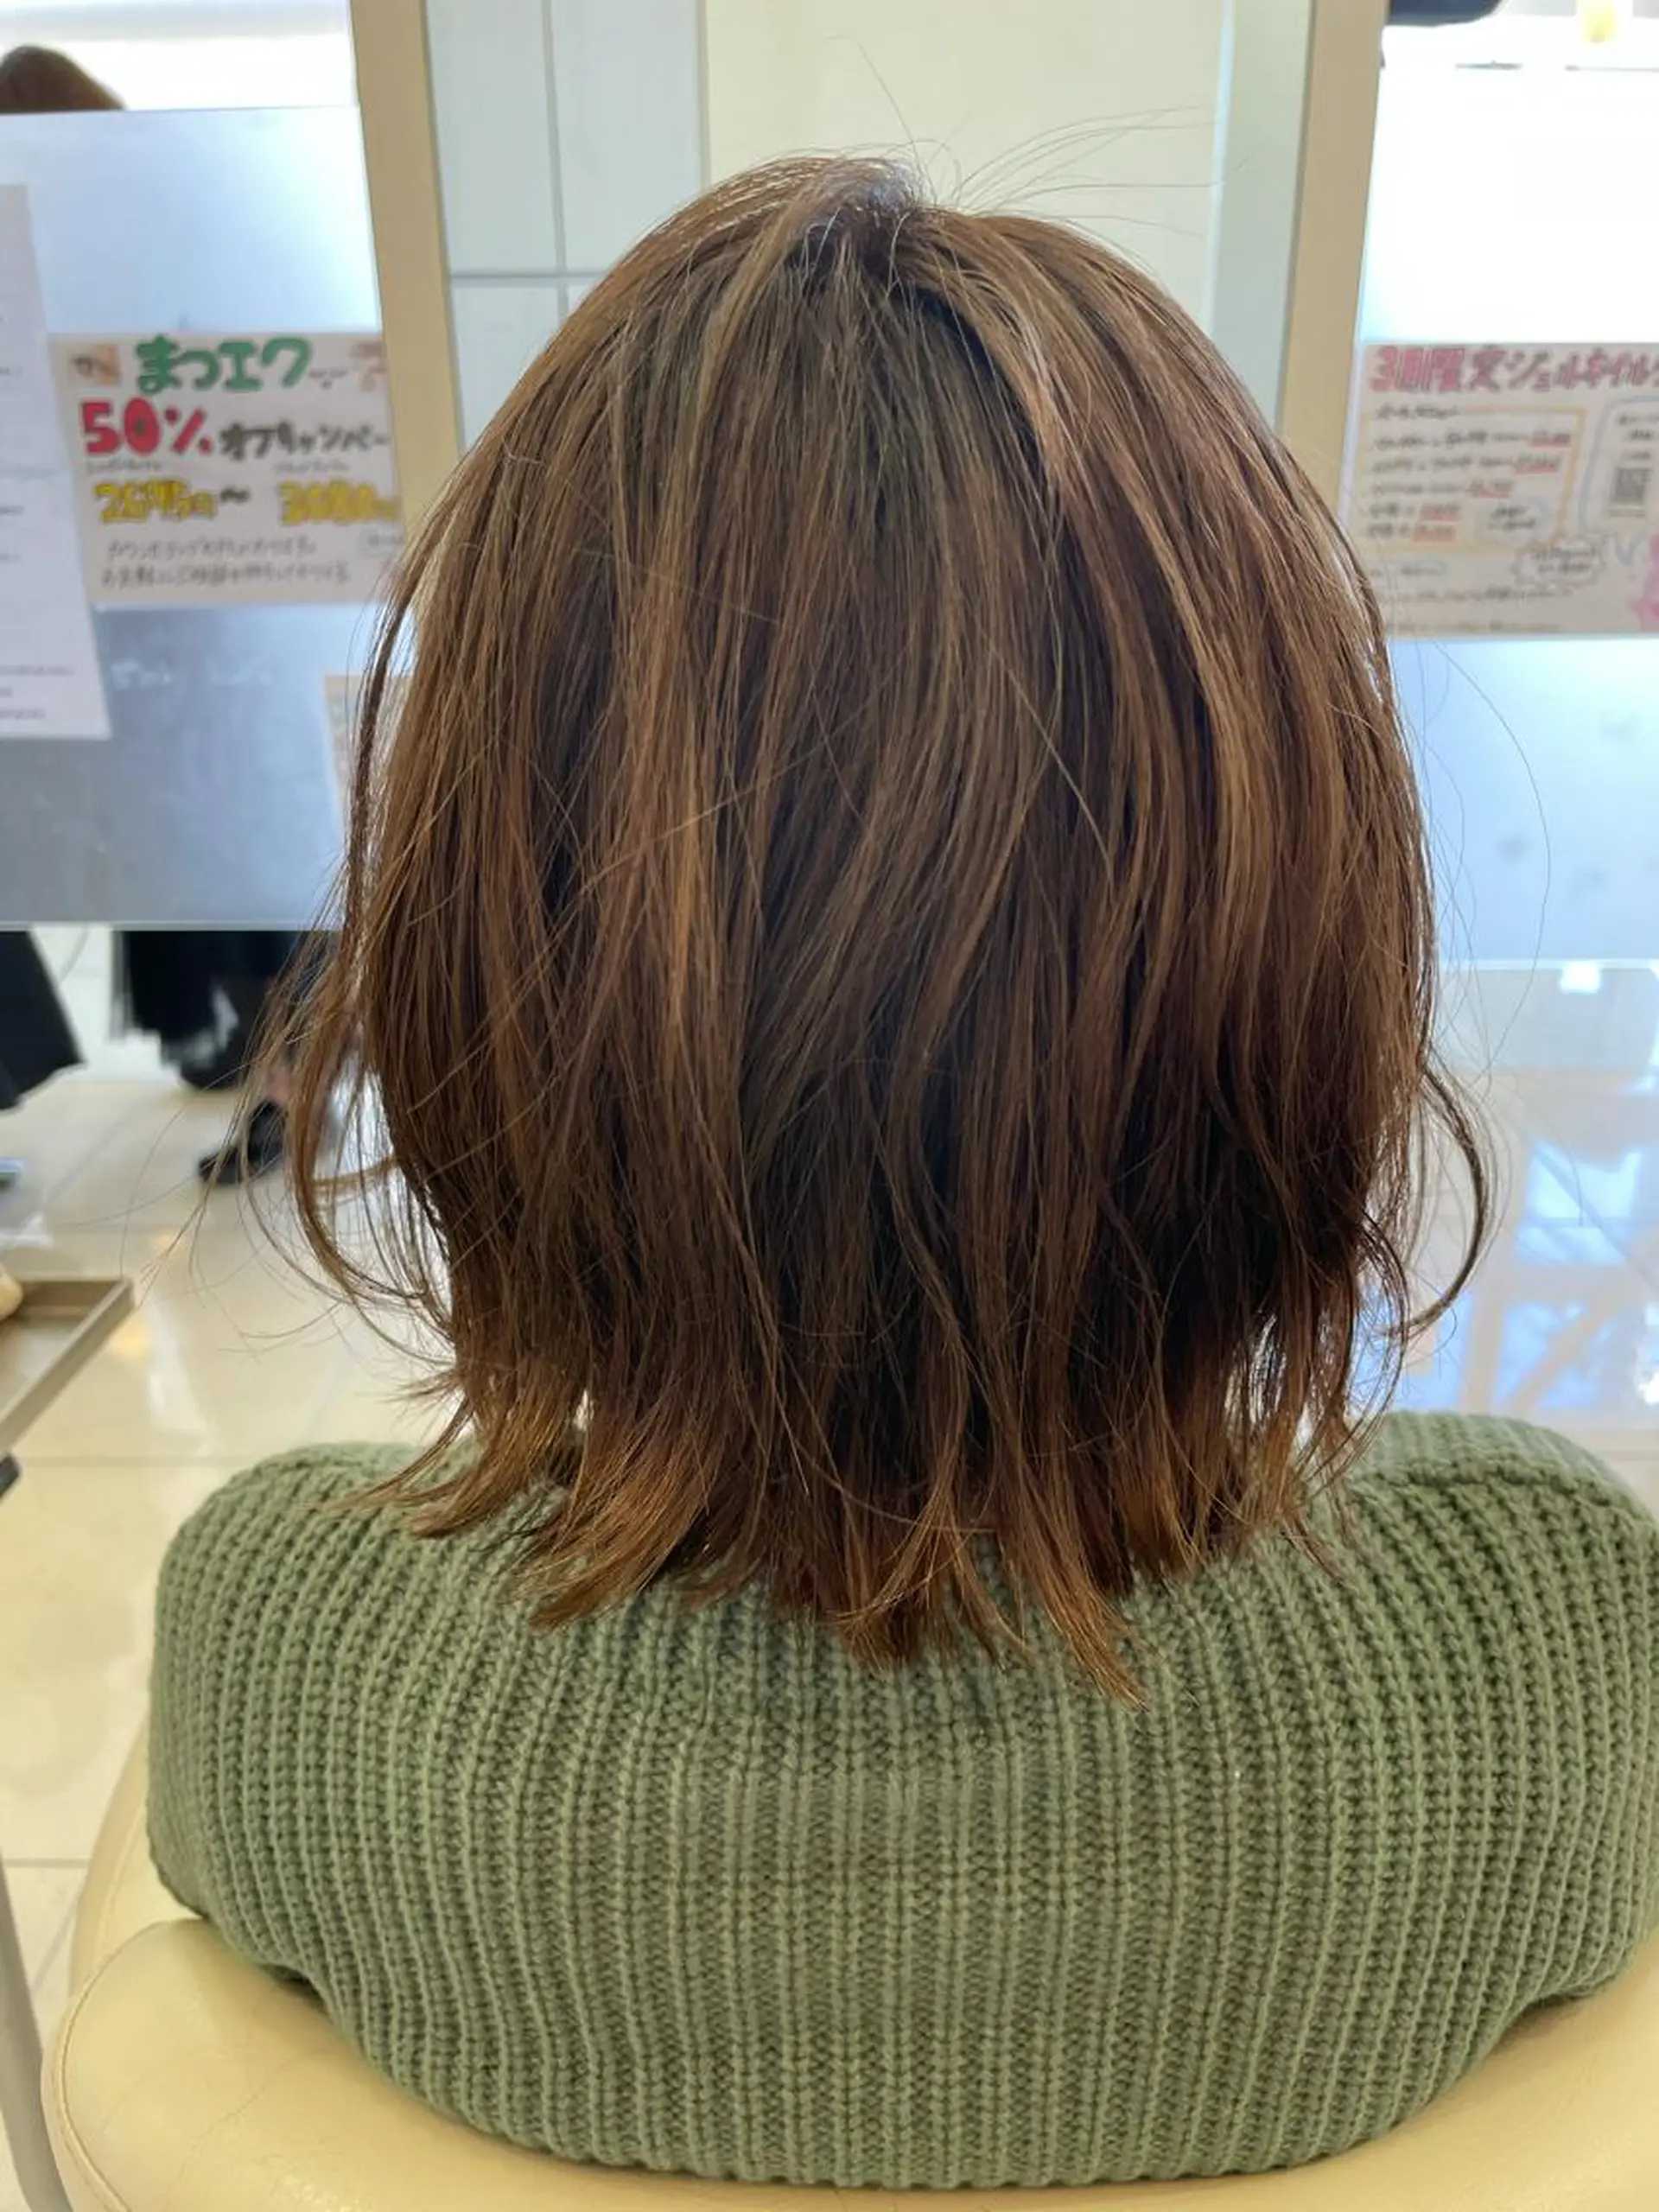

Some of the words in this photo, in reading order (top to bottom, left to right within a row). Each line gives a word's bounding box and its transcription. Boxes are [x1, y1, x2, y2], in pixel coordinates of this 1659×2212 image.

[135, 334, 313, 394] まつエク
[79, 398, 213, 456] 50%
